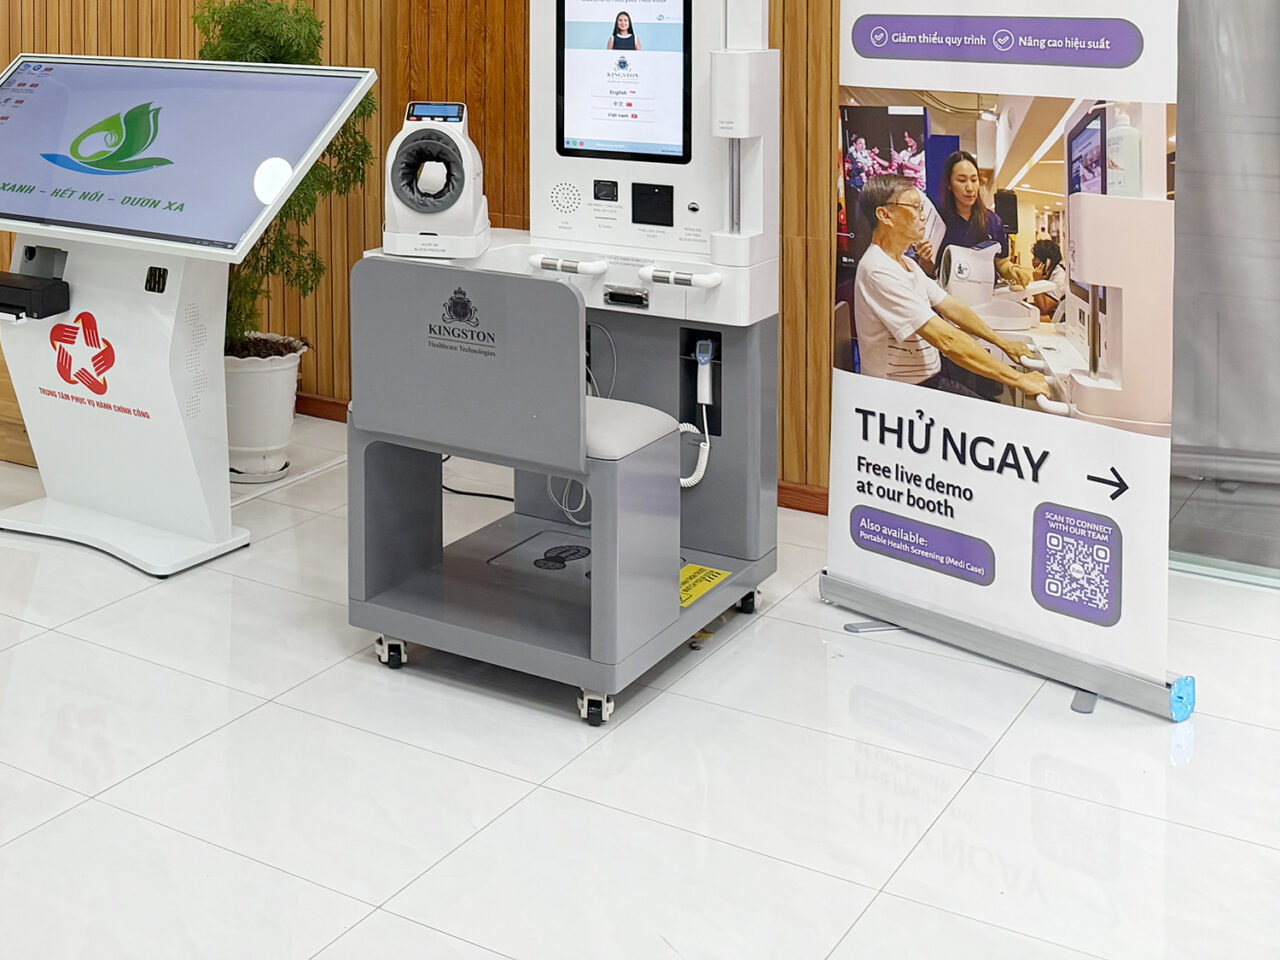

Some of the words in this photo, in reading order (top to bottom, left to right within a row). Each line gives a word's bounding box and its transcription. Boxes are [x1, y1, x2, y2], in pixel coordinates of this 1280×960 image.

[891, 33, 917, 44] Giảm
[918, 31, 944, 44] thiểu
[945, 36, 963, 47] quy
[963, 33, 987, 45] trình
[1018, 36, 1046, 49] Nâng
[1047, 39, 1063, 48] cao
[1065, 37, 1086, 50] hiệu
[1087, 36, 1111, 49] suất
[163, 201, 185, 212] XA
[429, 324, 495, 343] KINGSTON
[428, 340, 458, 351] Healthcare
[459, 345, 496, 357] Technologies
[38, 387, 57, 398] TRUNG
[58, 391, 70, 401] TÂM
[71, 394, 87, 406] PHỤC
[87, 398, 95, 408] VỤ
[96, 400, 112, 411] HÀNH
[113, 404, 132, 415] CHÍNH
[133, 408, 151, 419] CÔNG
[855, 407, 935, 455] THỬ
[941, 428, 1050, 484] NGAY
[856, 455, 892, 479] Free
[894, 465, 922, 488] live
[925, 472, 974, 502] demo
[856, 479, 873, 494] at
[877, 487, 904, 503] our
[906, 489, 955, 519] booth
[859, 517, 881, 532] Also
[882, 525, 929, 547] available:
[1045, 511, 1065, 523] SCAN
[1065, 516, 1075, 526] TO
[1076, 520, 1113, 534] CONNECT
[1048, 520, 1068, 532] WITH
[1069, 526, 1087, 537] OUR
[1087, 530, 1109, 542] TEAM
[859, 531, 887, 546] Portable
[887, 539, 910, 552] Health
[911, 546, 945, 564] Screening
[945, 555, 965, 569] (Medi
[966, 563, 985, 576] Case)
